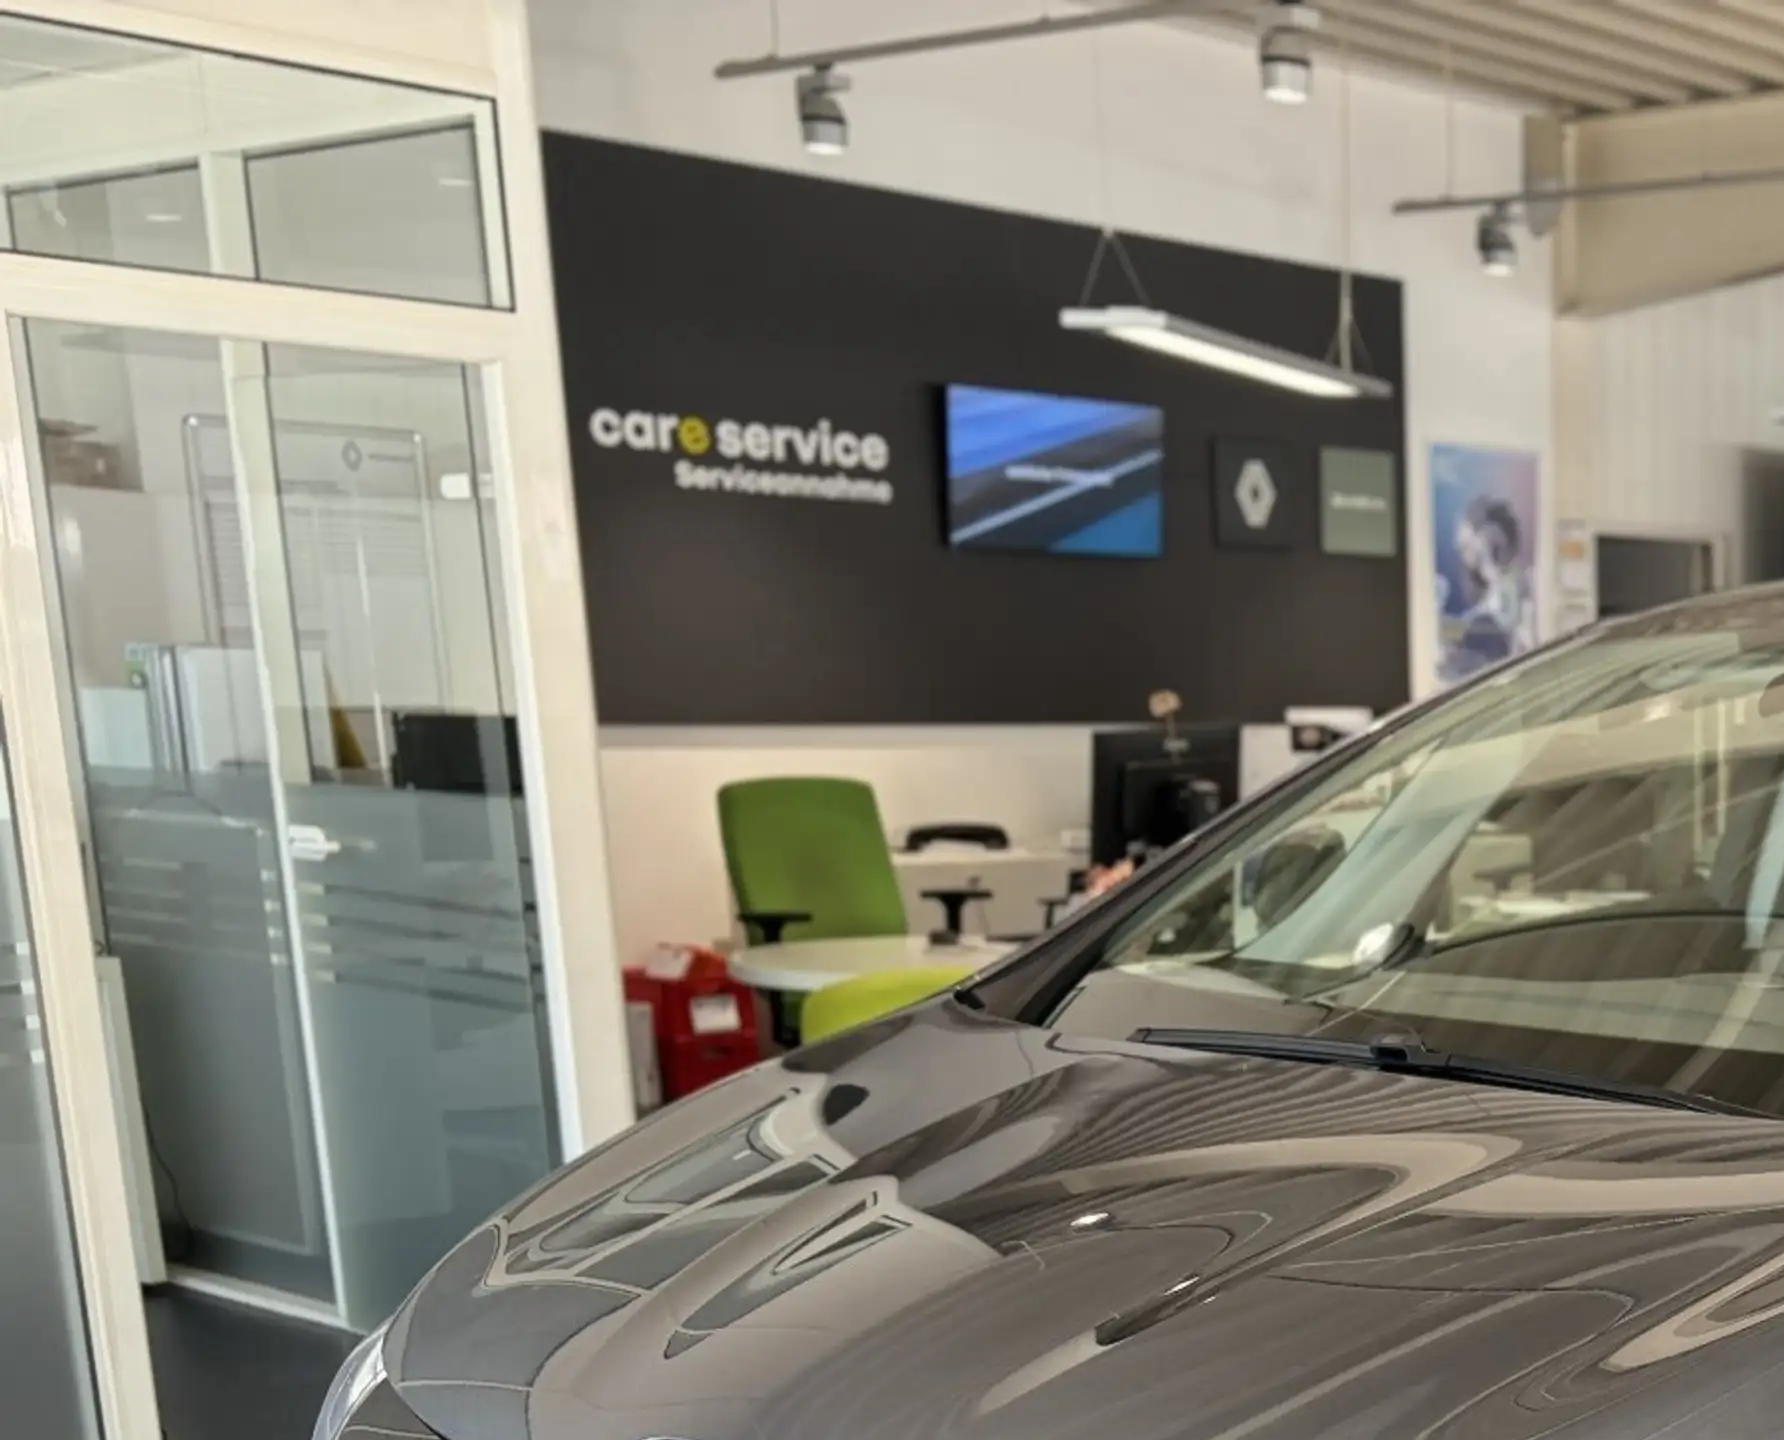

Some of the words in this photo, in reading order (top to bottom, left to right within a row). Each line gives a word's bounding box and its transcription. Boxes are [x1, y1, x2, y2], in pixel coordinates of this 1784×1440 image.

[589, 407, 711, 455] care
[715, 417, 891, 472] service
[674, 459, 894, 505] Serviceannahme
